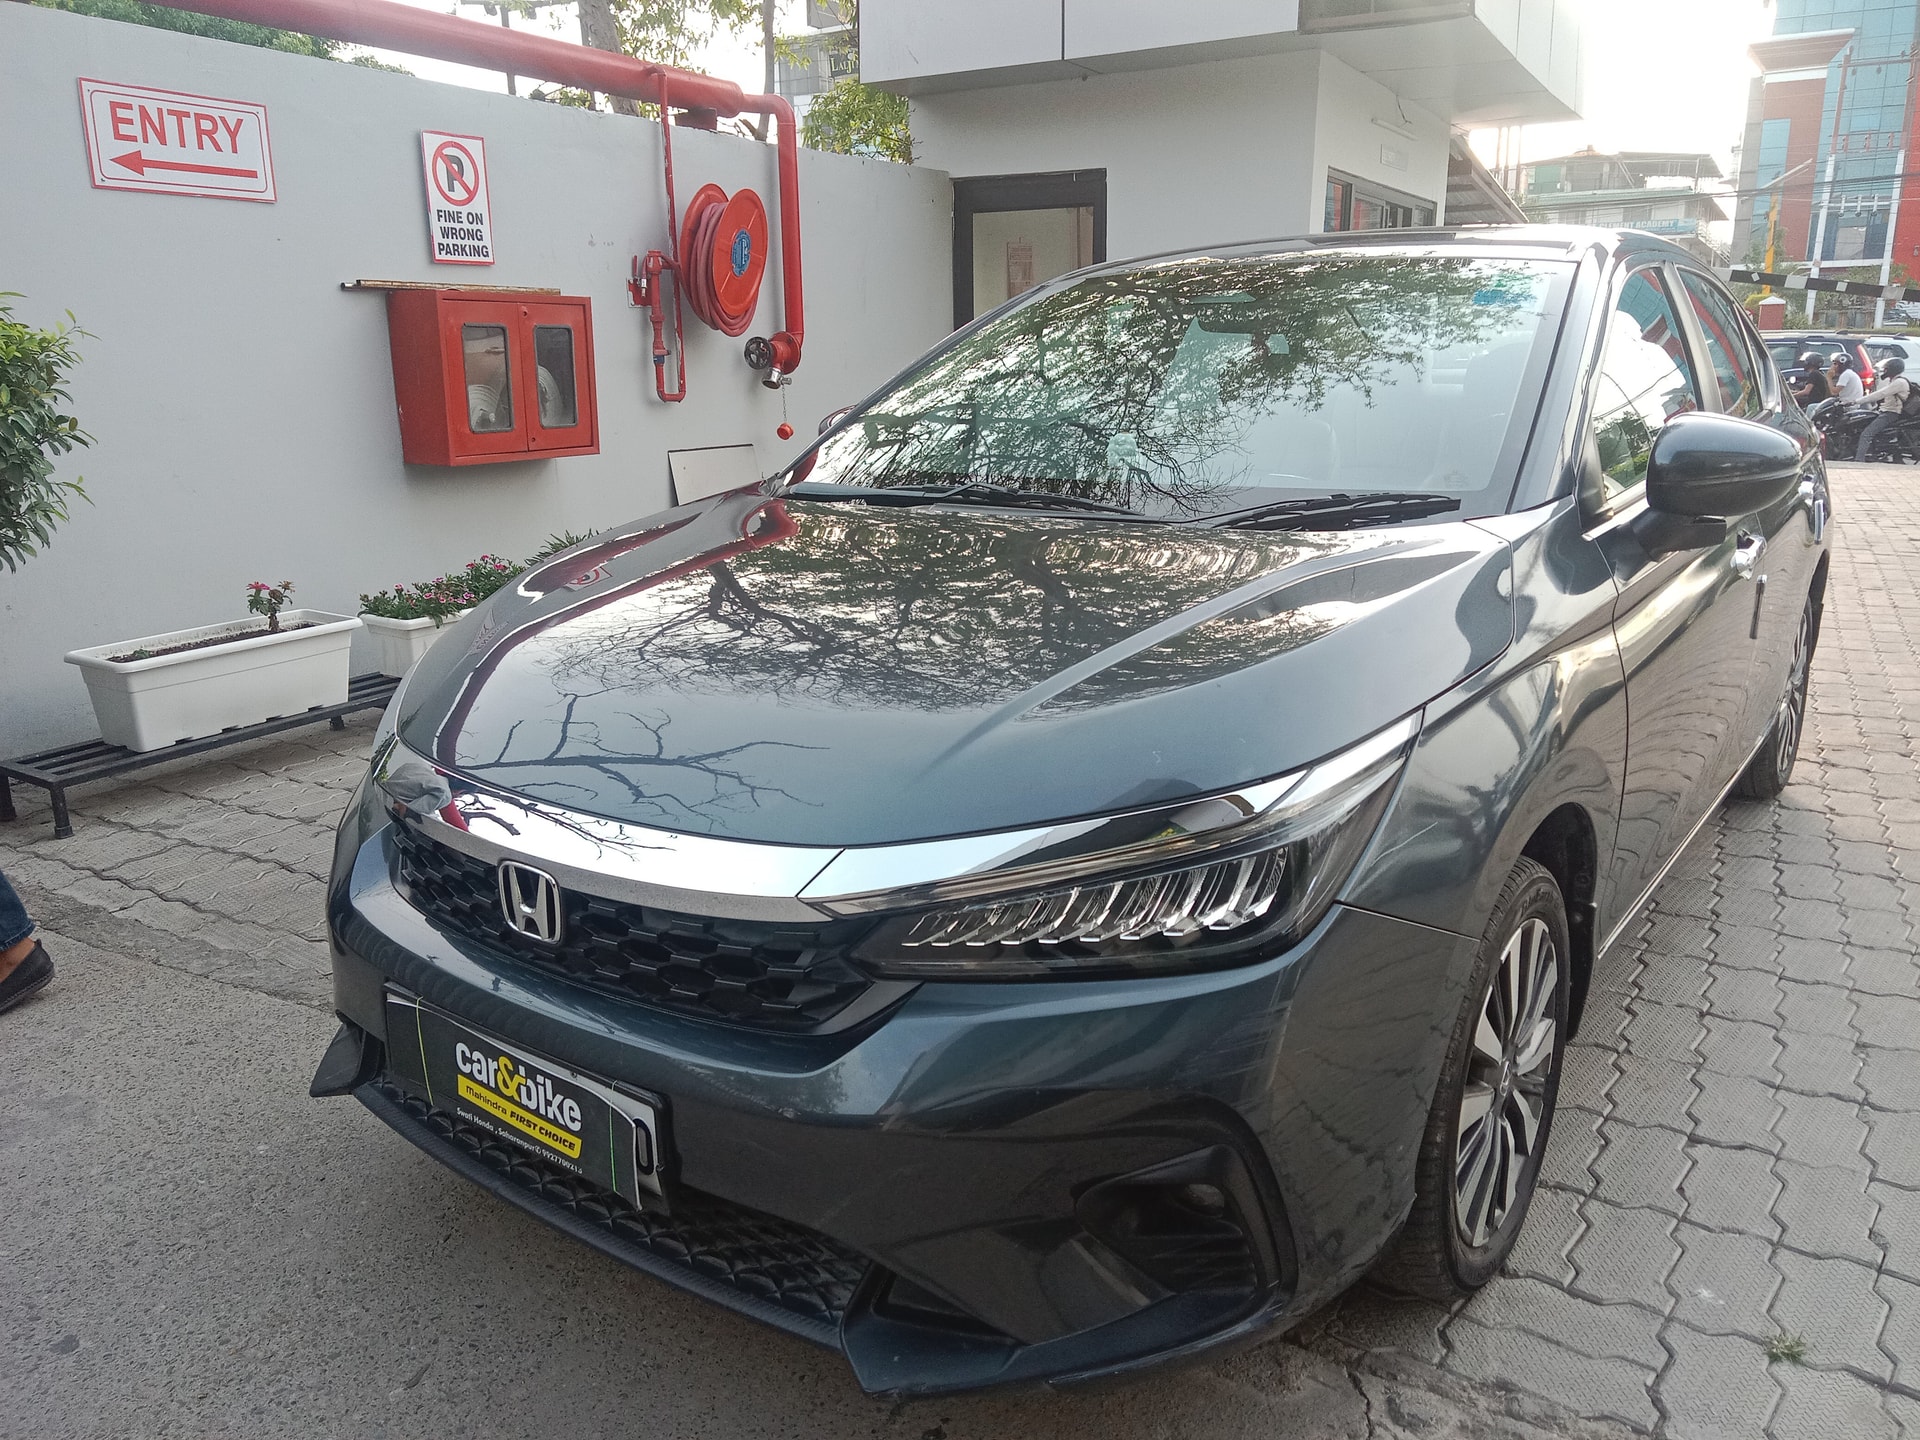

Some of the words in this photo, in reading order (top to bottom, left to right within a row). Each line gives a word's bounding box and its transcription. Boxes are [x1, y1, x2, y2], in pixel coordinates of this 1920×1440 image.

[109, 100, 244, 154] ENTRY
[436, 209, 464, 224] FINE
[466, 212, 484, 226] ON
[1636, 219, 1675, 229] ACADEMY
[440, 226, 484, 242] WRONG
[437, 242, 490, 258] PARKING
[456, 1042, 582, 1132] car&bike
[465, 1084, 507, 1115] Mahindra
[510, 1111, 538, 1131] FIRST
[539, 1126, 576, 1151] CHOICE
[474, 1115, 494, 1131] Honda
